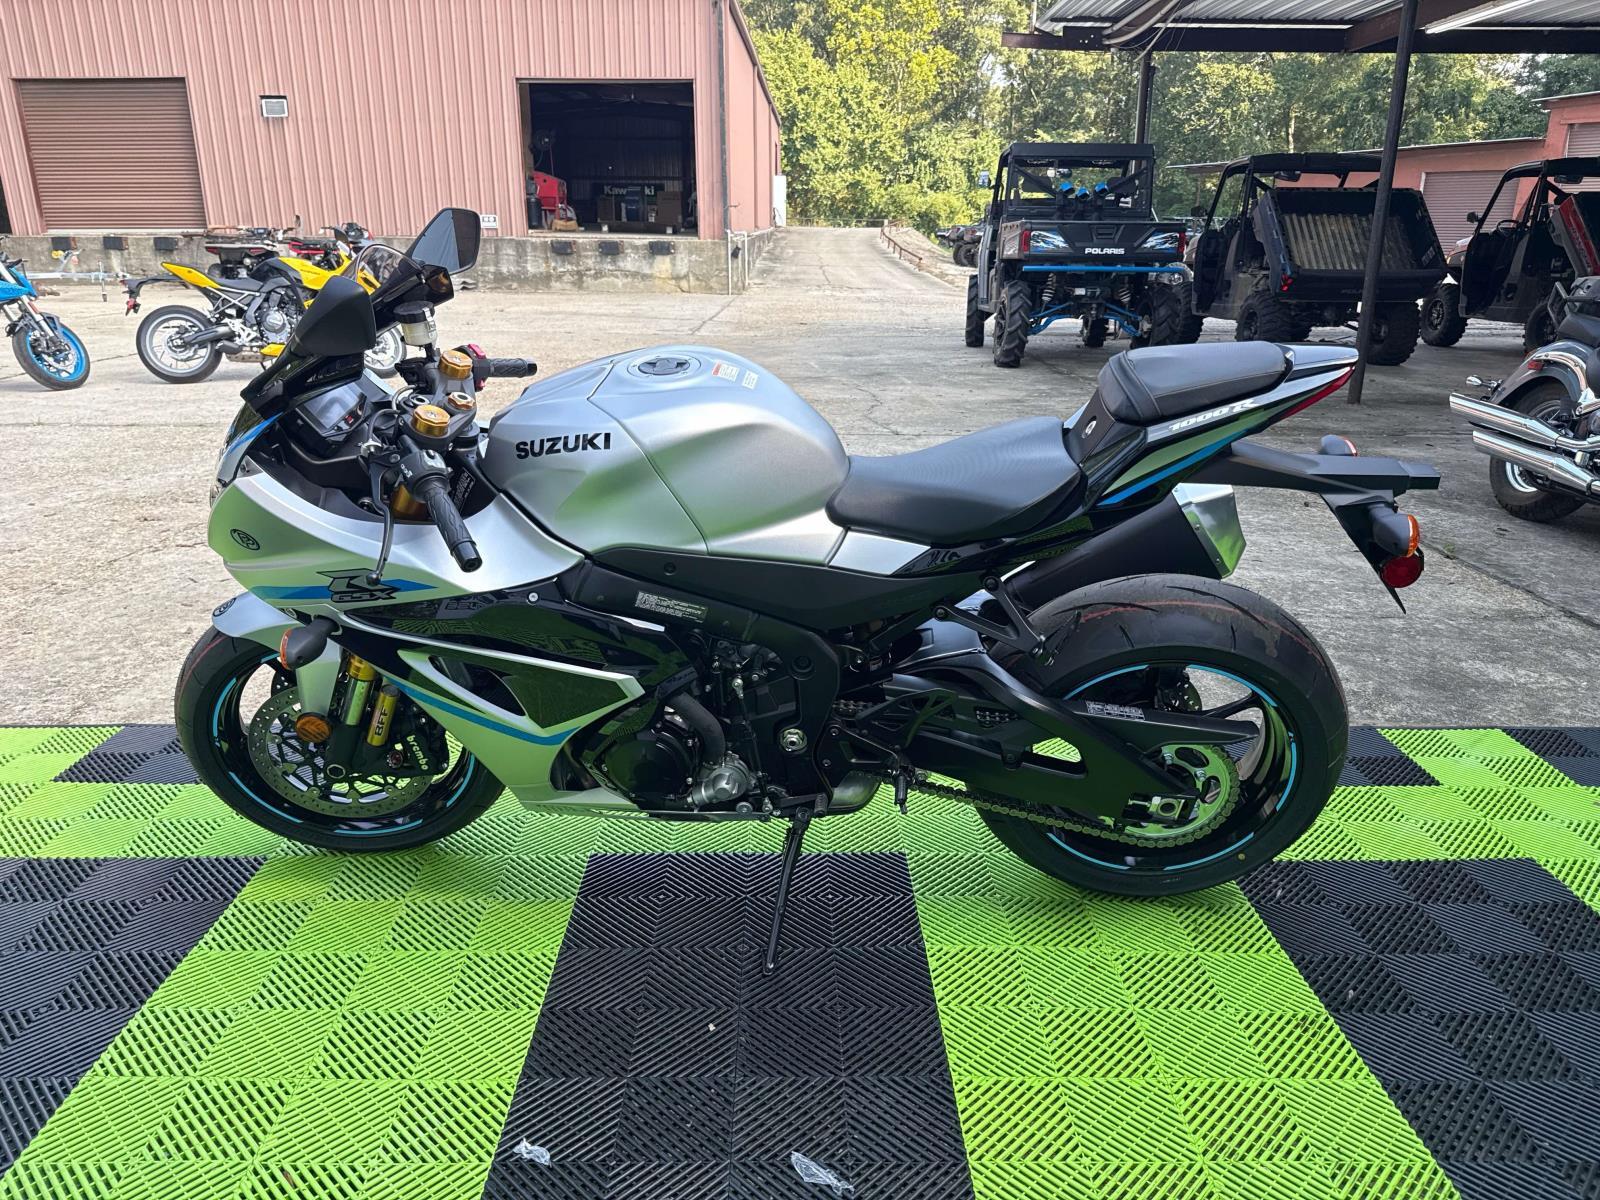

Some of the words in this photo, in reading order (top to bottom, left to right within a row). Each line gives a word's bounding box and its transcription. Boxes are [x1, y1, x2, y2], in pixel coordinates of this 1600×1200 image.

[603, 185, 655, 196] Kawki
[1085, 247, 1125, 255] POLARIS
[515, 432, 611, 459] SUZUKI
[374, 707, 389, 737] BFF
[406, 735, 429, 770] brembo
